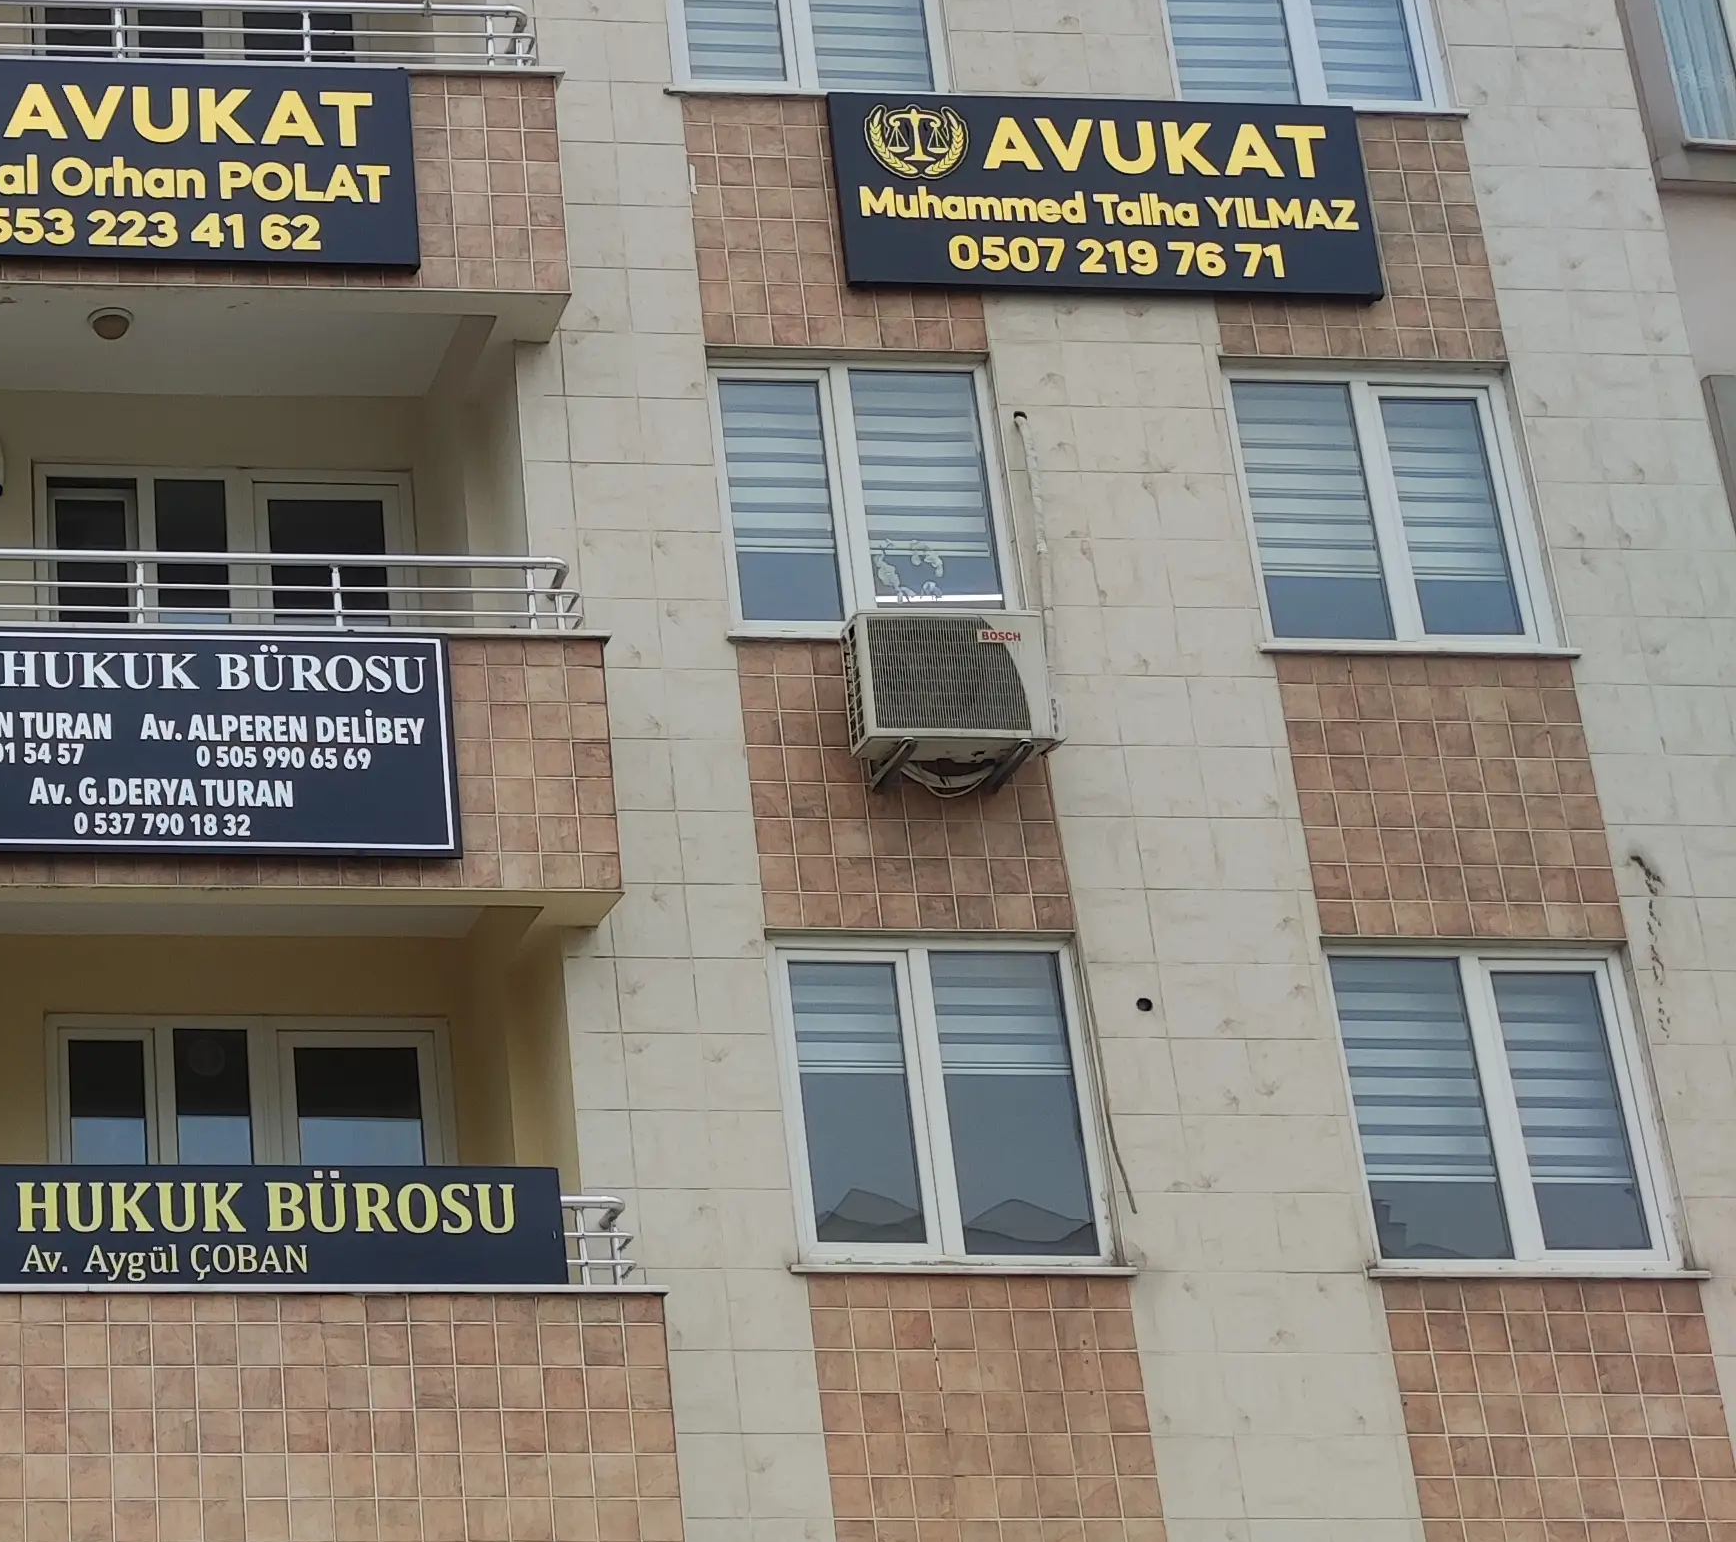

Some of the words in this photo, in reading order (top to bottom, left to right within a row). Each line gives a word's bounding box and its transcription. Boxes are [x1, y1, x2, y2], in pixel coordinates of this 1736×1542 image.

[3, 83, 373, 147] AVUKAT
[983, 116, 1326, 178] AVUKAT
[51, 156, 206, 199] Orhan
[218, 161, 391, 203] POLAT
[858, 185, 1086, 224] Muhammed
[1092, 192, 1199, 227] Talha
[1205, 196, 1360, 231] YILMAZ
[87, 210, 179, 248] 223
[190, 213, 245, 249] 41
[260, 214, 322, 251] 62
[948, 234, 1065, 271] 0507
[1076, 238, 1158, 276] 219
[1167, 241, 1226, 277] 76
[1234, 243, 1286, 278] 71
[981, 631, 1021, 642] BOSCH
[0, 650, 200, 690] HUKUK
[216, 644, 427, 693] BÜROSU
[20, 712, 112, 740] TURAN
[140, 713, 183, 742] Av.
[188, 714, 307, 743] ALPEREN
[316, 708, 425, 745] DELİBEY
[23, 743, 53, 764] 54
[57, 743, 84, 765] 57
[196, 745, 210, 767] 0
[215, 745, 257, 768] 505
[263, 746, 305, 769] 990
[310, 747, 338, 769] 65
[343, 747, 372, 770] 69
[29, 778, 72, 806] Av.
[79, 777, 197, 807] G.DERYA
[201, 780, 293, 808] TURAN
[74, 812, 88, 834] 0
[93, 813, 135, 835] 537
[141, 813, 184, 836] 790
[190, 814, 217, 836] 18
[222, 814, 250, 837] 32
[18, 1181, 247, 1233] HUKUK
[265, 1169, 515, 1235] BÜROSU
[21, 1246, 68, 1274] Av.
[83, 1243, 179, 1282] Aygül
[189, 1246, 308, 1282] ÇOBAN
